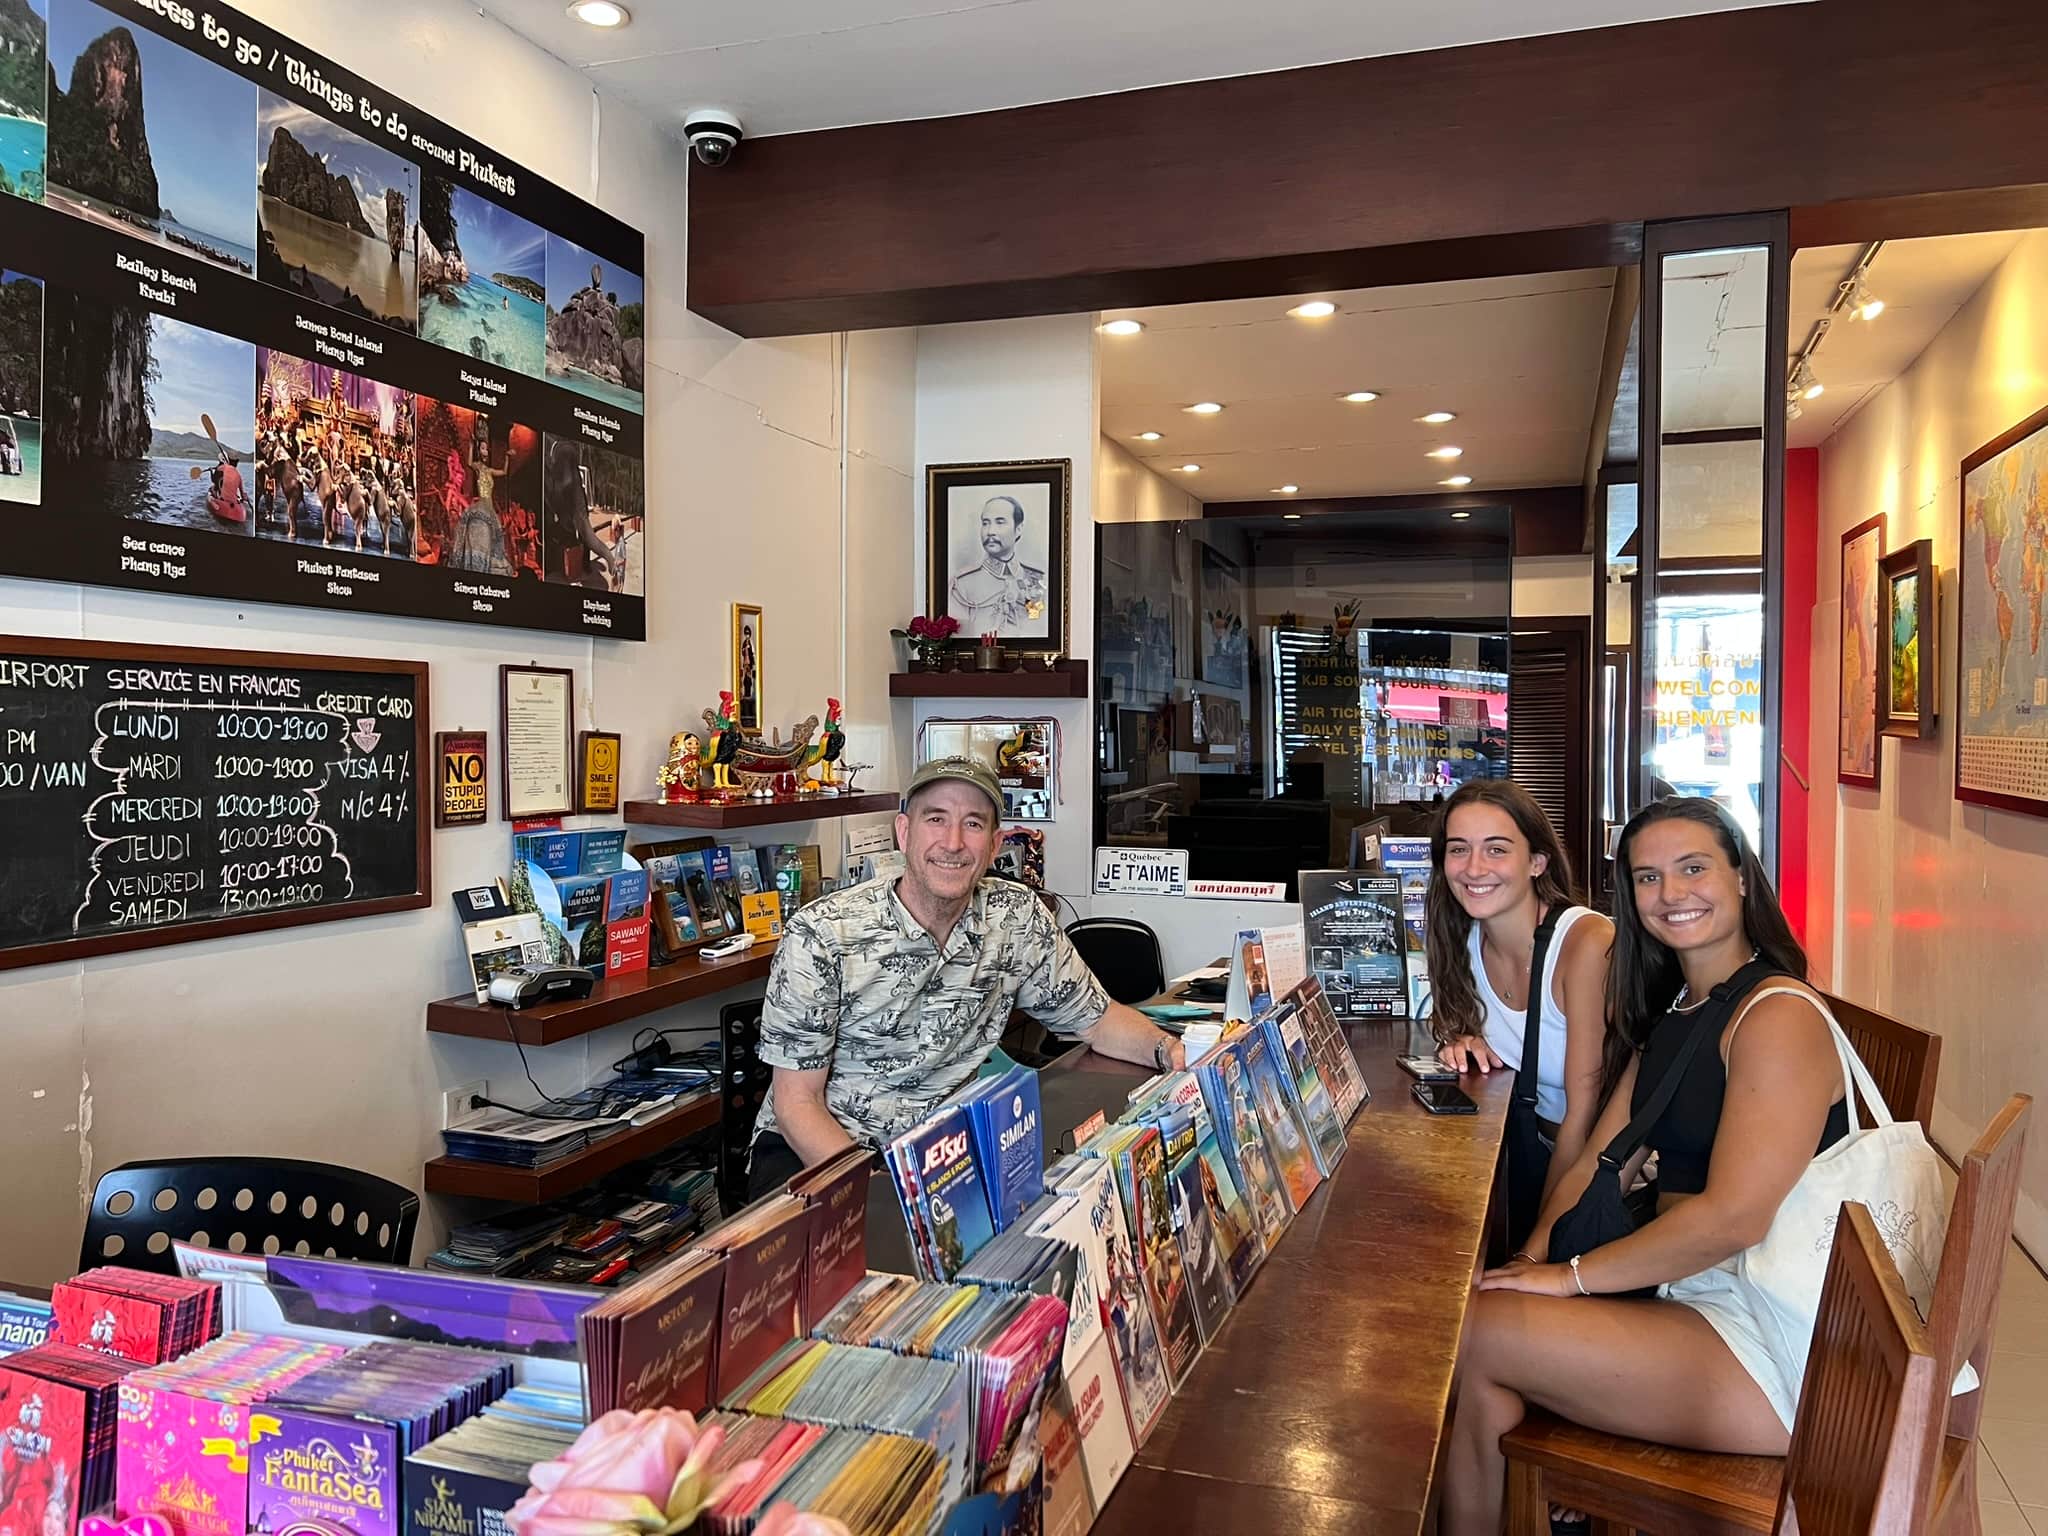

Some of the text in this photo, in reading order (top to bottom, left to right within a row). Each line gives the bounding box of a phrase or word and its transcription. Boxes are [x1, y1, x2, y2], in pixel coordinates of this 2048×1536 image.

[201, 12, 230, 49] to
[235, 36, 262, 64] go
[267, 49, 279, 72] /
[284, 54, 354, 112] Things
[359, 97, 381, 128] to
[386, 112, 408, 141] do
[411, 134, 455, 166] around
[458, 148, 516, 197] Phuket
[116, 253, 197, 293] Railey Beach
[138, 281, 176, 306] Krabi
[295, 314, 383, 354] James Bond Island
[315, 340, 365, 367] Phang Nga
[483, 376, 507, 394] Island
[469, 389, 498, 407] Phuket
[122, 535, 185, 557] Sea canoe
[121, 556, 186, 579] Phang Nga
[297, 559, 333, 576] Phuket
[326, 582, 353, 596] Show
[453, 581, 511, 599] Simon Cabaret
[472, 599, 493, 612] Show
[107, 668, 193, 692] SERVICE
[199, 674, 222, 693] EN
[229, 674, 300, 698] FRANCAIS
[1302, 675, 1328, 686] KJB
[1391, 679, 1431, 690] TOUR
[316, 691, 413, 720] CREDIT CARD
[1302, 706, 1325, 718] AIR
[113, 713, 179, 741] LUNDI
[1302, 723, 1343, 736] DAILY
[8, 729, 36, 754] PM
[129, 752, 182, 781] MARDI
[338, 757, 378, 780] VISA
[445, 755, 484, 783] NO
[590, 774, 613, 783] SMILE
[445, 785, 484, 798] STUPID
[111, 797, 202, 822] MERCREDI
[445, 798, 484, 811] PEOPLE
[117, 836, 190, 863] JEUDI
[1398, 844, 1431, 854] Similan
[1102, 864, 1180, 883] JE T'AIME
[107, 878, 205, 897] VENDREDI
[474, 894, 490, 903] VISA
[108, 898, 189, 925] SAMEDI
[1352, 908, 1371, 918] Trip
[1000, 1109, 1036, 1152] SIMILAN
[1167, 1128, 1194, 1156] DAY TRIP
[2, 1312, 48, 1329] Travel & Tour
[283, 1448, 334, 1475] Phuket
[263, 1456, 384, 1510] FantaSea
[423, 1497, 465, 1519] SIAM
[414, 1508, 475, 1535] NIRAMIT
